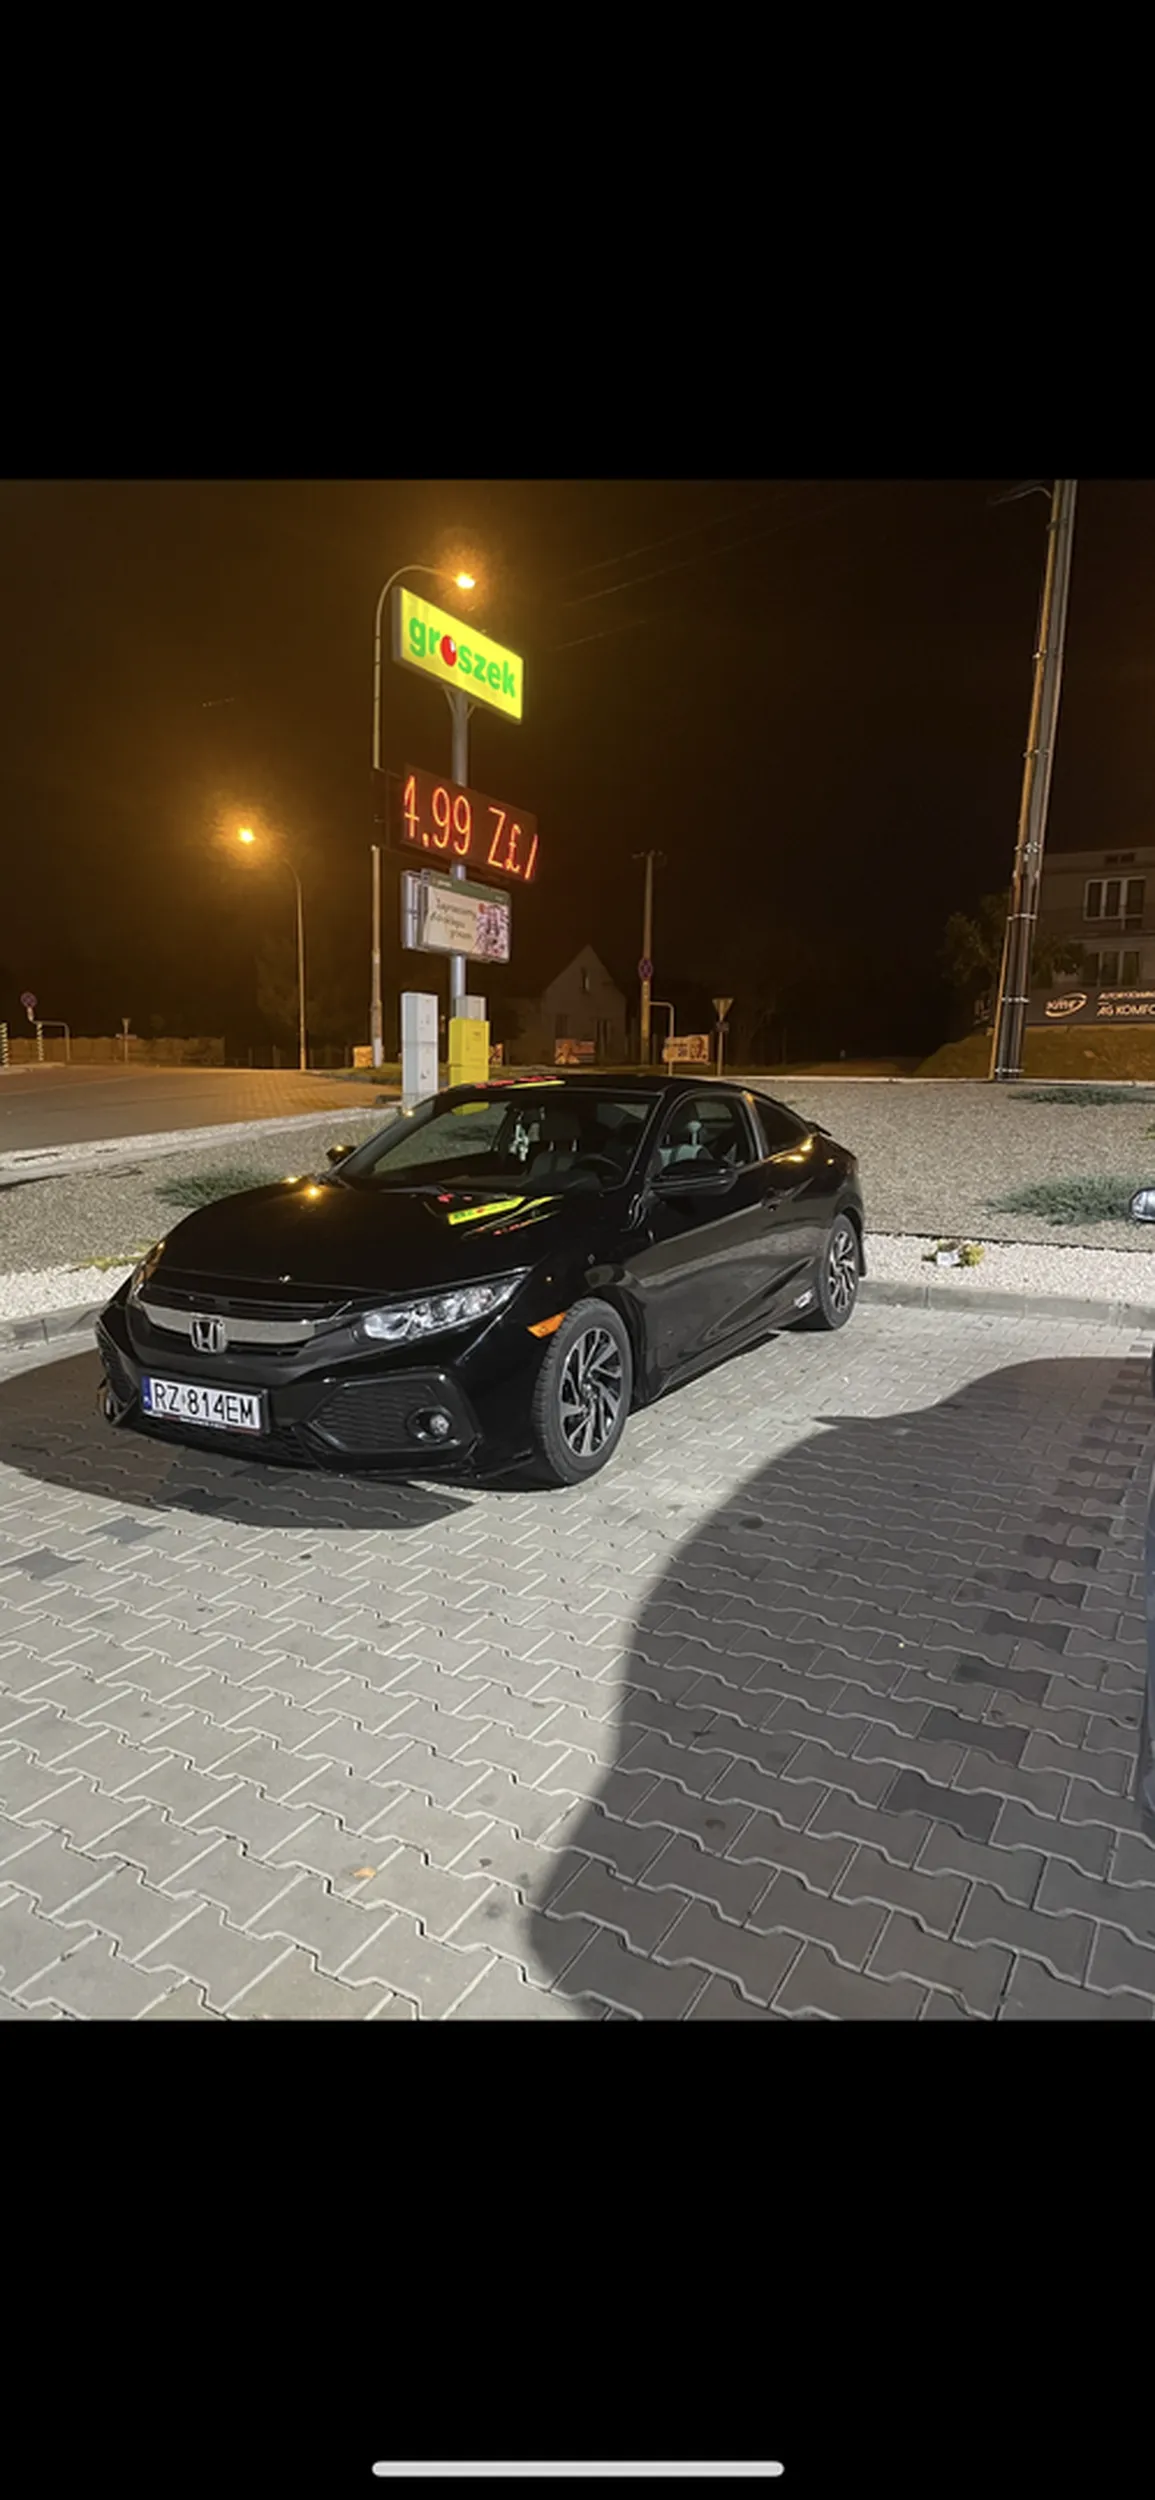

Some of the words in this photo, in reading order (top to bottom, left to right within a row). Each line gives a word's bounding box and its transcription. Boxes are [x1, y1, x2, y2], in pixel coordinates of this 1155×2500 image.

[409, 616, 516, 698] groszek
[154, 1382, 181, 1412] RZ
[188, 1389, 255, 1425] 814EM
